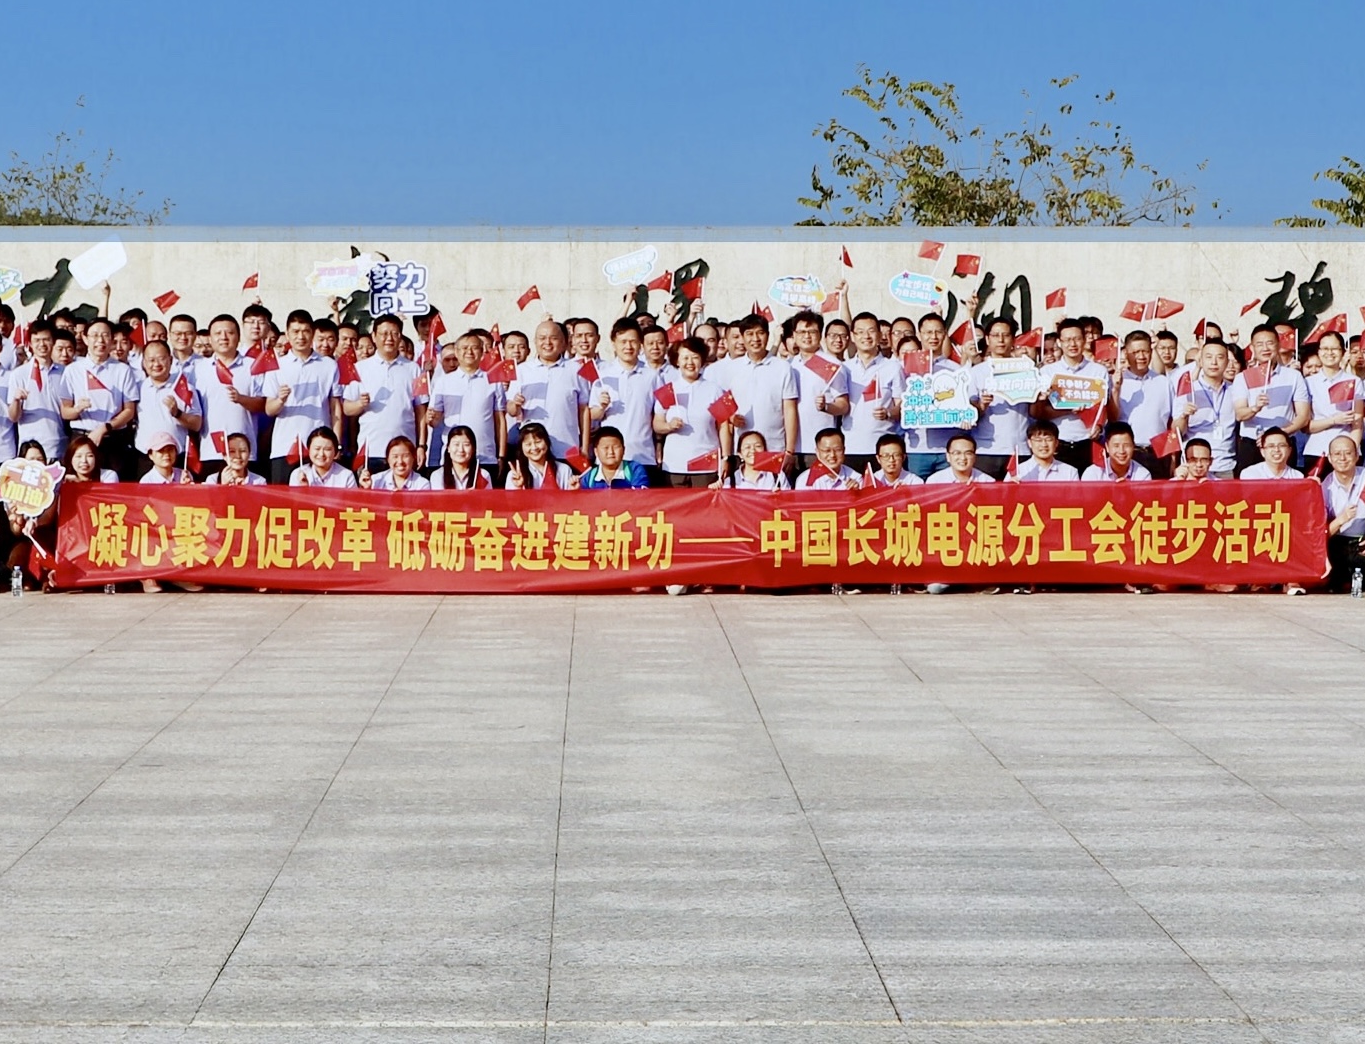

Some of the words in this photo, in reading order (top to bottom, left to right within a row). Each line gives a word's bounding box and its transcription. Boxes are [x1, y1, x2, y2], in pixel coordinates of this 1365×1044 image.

[372, 263, 425, 289] 努力
[372, 289, 428, 314] 向上
[4, 480, 44, 507] 加油
[89, 503, 378, 571] 凝心聚力促改革
